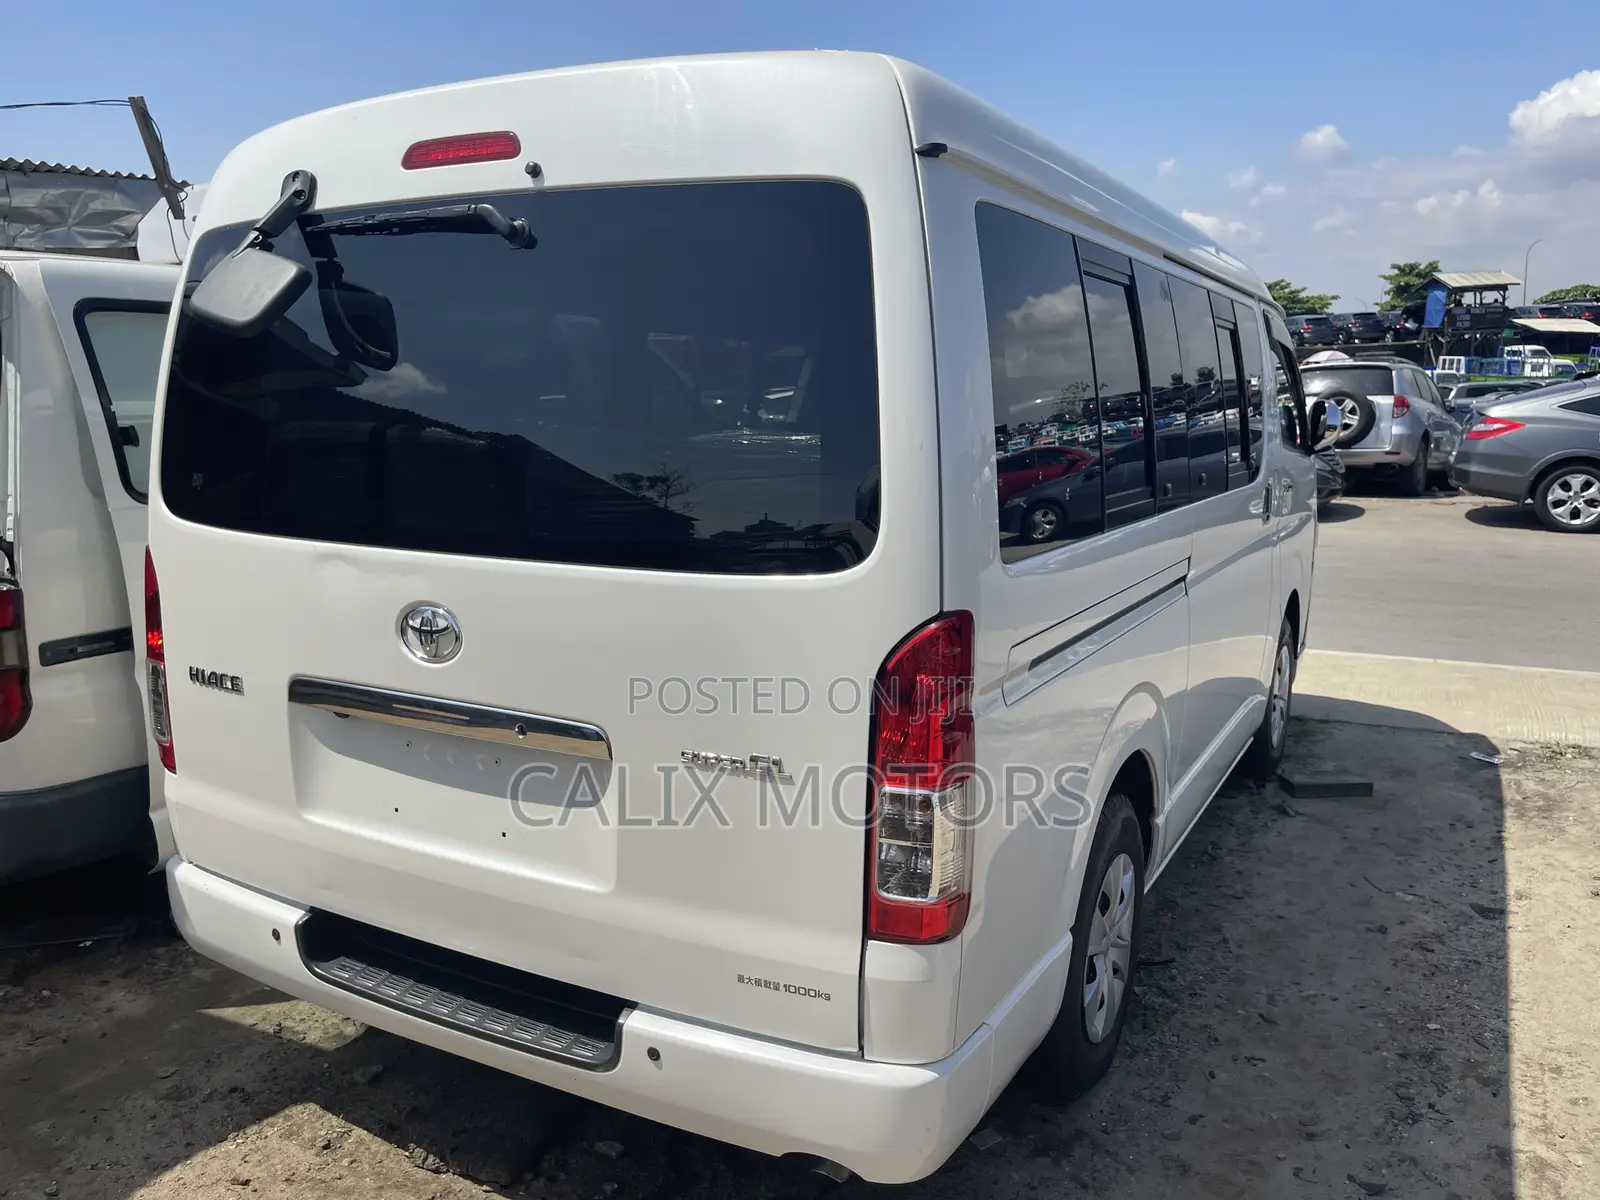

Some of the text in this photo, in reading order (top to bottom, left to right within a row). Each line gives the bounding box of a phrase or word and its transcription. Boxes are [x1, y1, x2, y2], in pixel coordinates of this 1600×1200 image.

[188, 665, 243, 694] HIACE
[737, 973, 832, 1002] 最大積載量 1000kg
